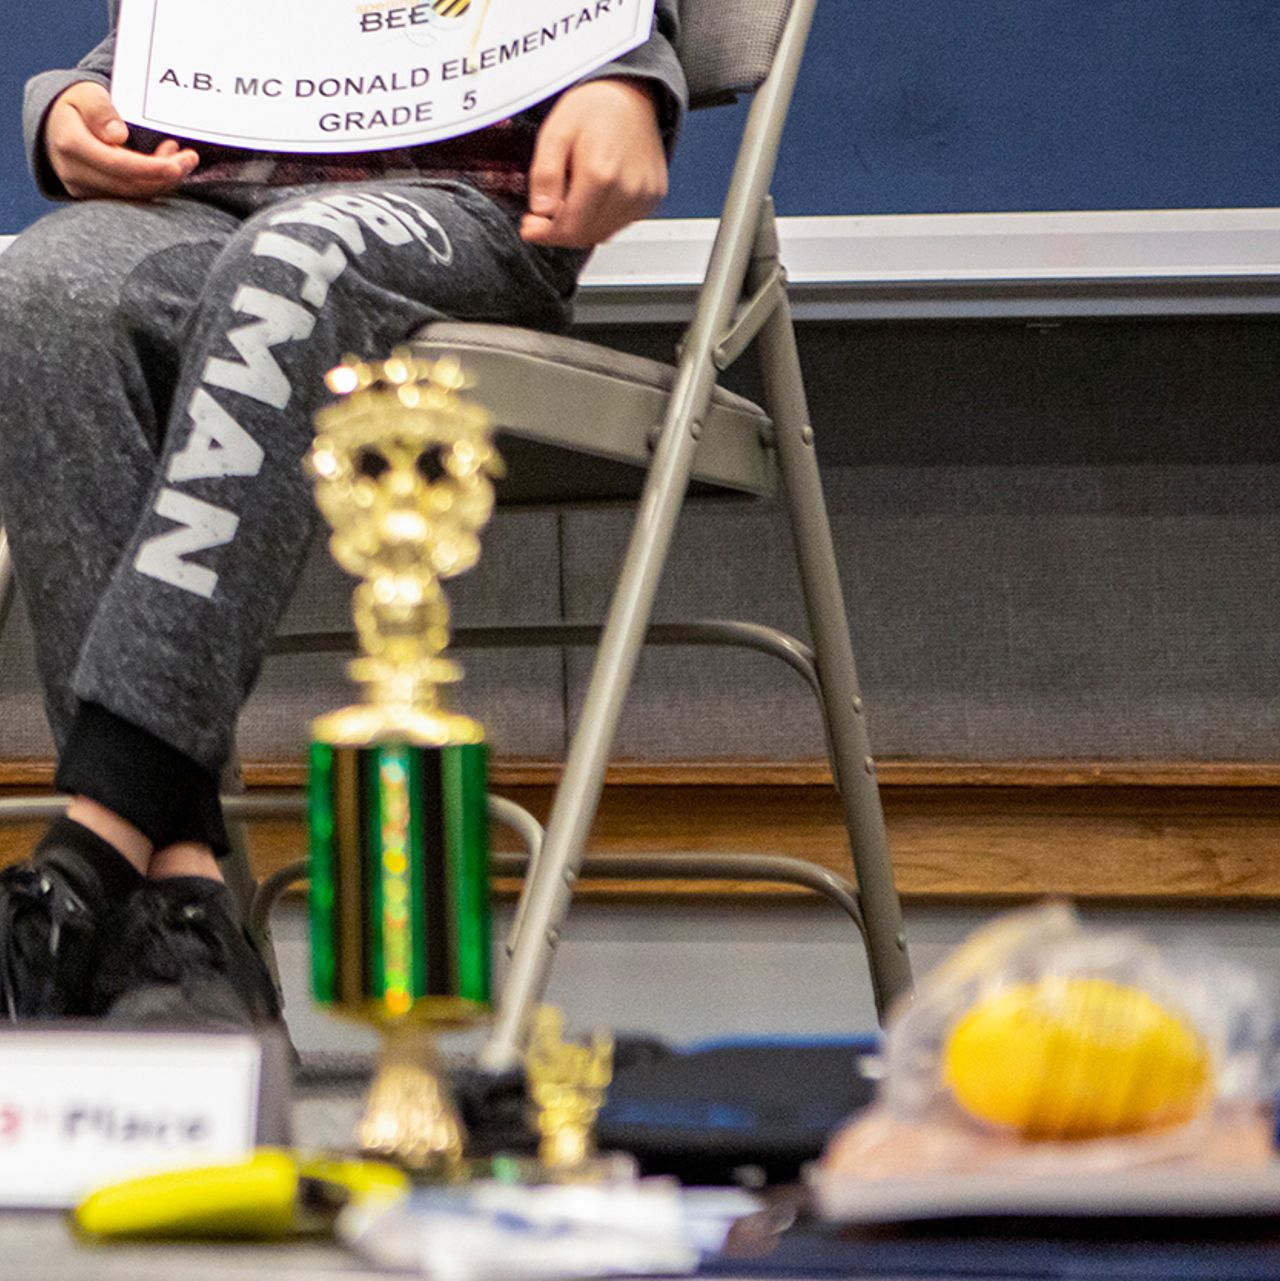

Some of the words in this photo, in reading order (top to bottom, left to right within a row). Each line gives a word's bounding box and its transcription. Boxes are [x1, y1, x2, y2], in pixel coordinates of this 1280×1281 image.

[359, 3, 430, 33] BEE
[159, 68, 222, 93] A.B.
[234, 76, 283, 97] MC
[294, 66, 430, 98] DONALD
[318, 101, 434, 133] GRADE
[461, 89, 478, 111] 5
